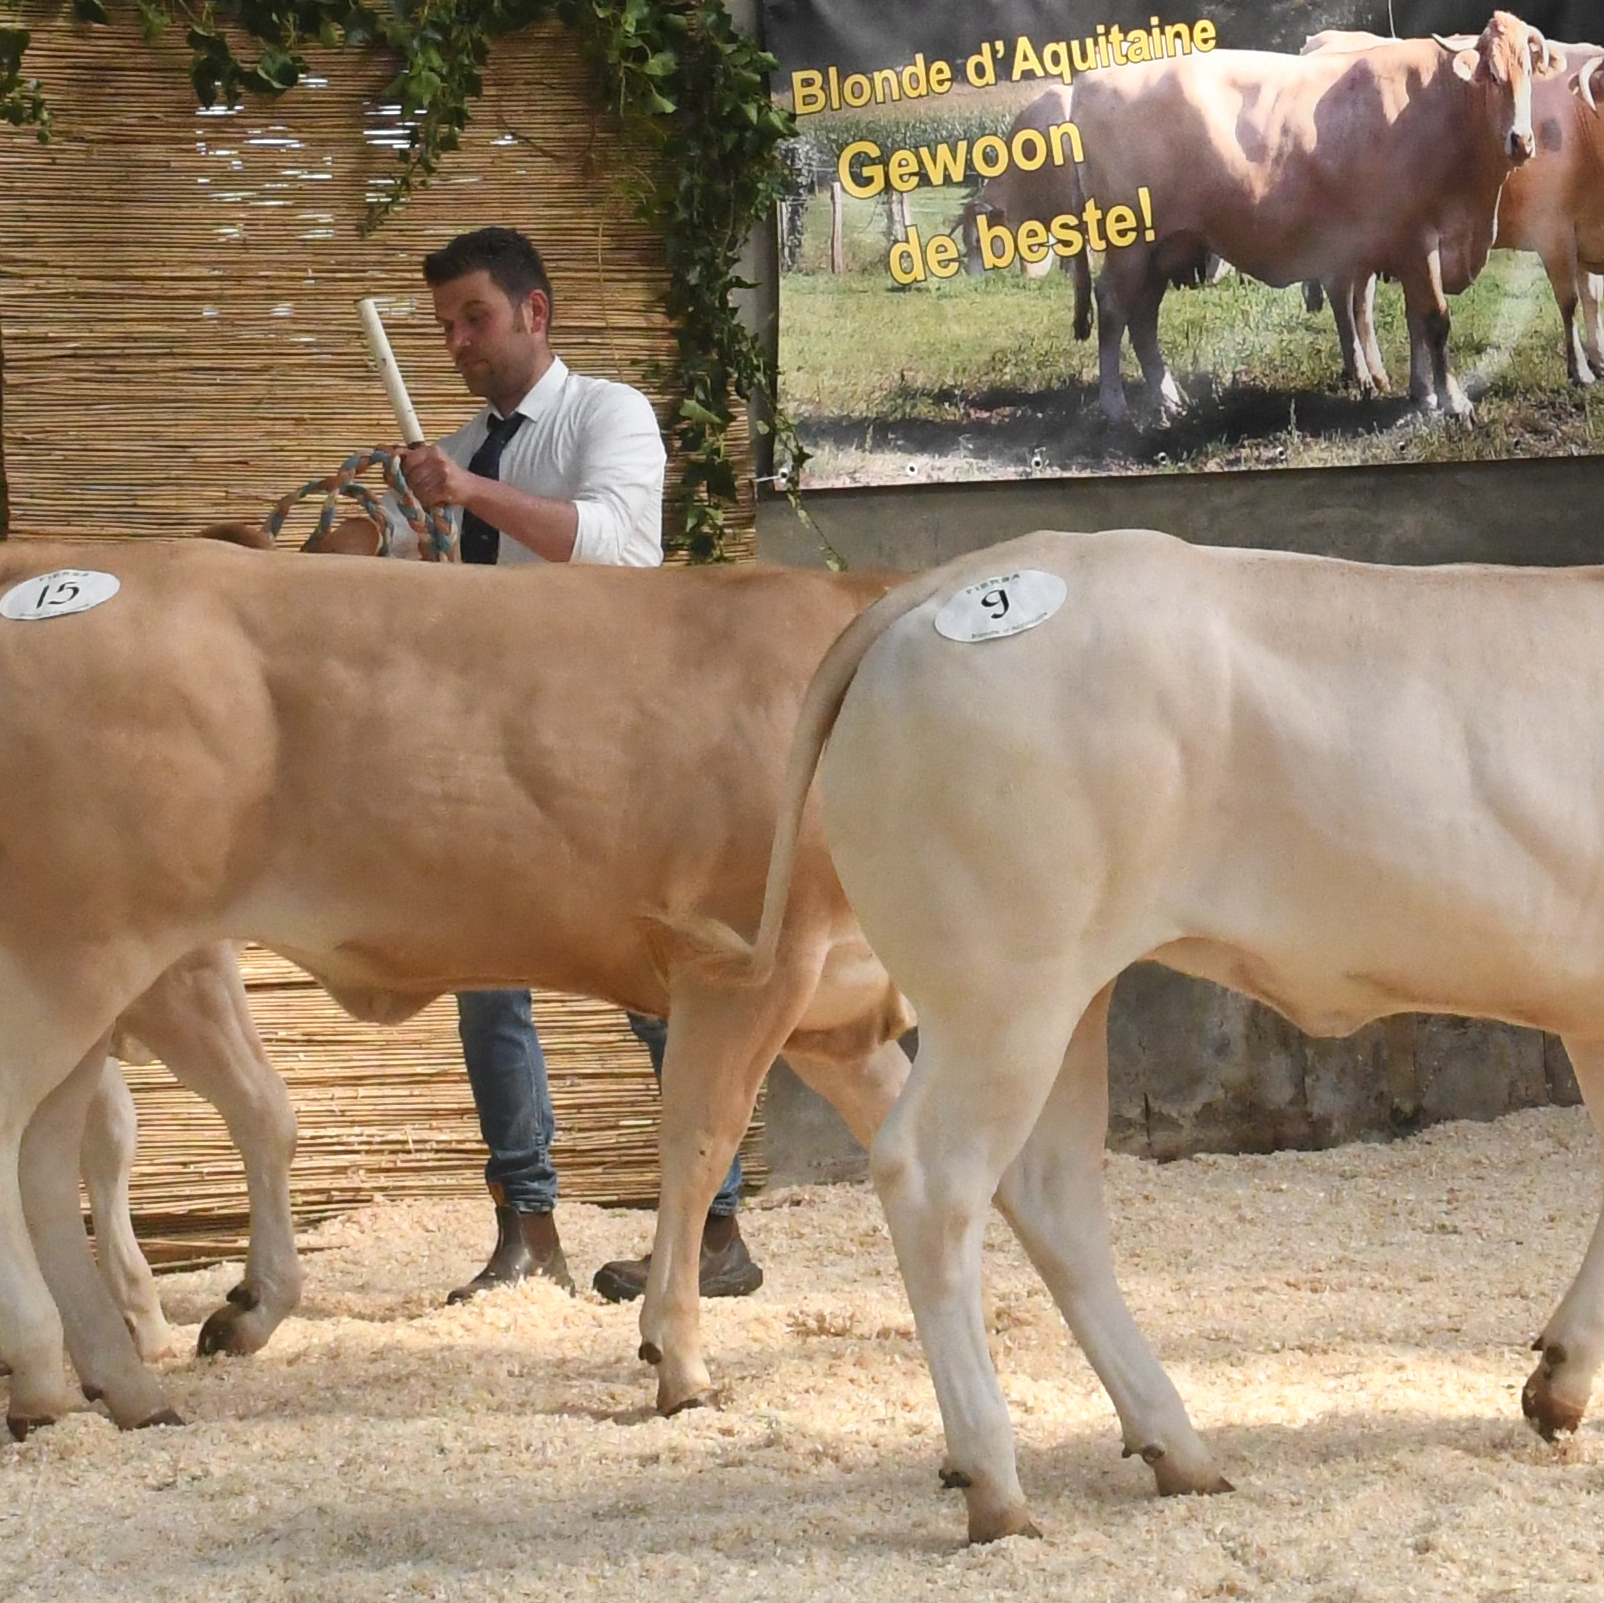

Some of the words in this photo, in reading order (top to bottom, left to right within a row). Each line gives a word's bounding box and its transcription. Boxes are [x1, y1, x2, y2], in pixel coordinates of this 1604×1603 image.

[791, 52, 953, 115] Blonde
[838, 119, 1085, 199] Gewoon
[888, 224, 960, 285] de
[976, 186, 1156, 271] beste!
[35, 581, 81, 609] 15
[981, 589, 1010, 619] 9
